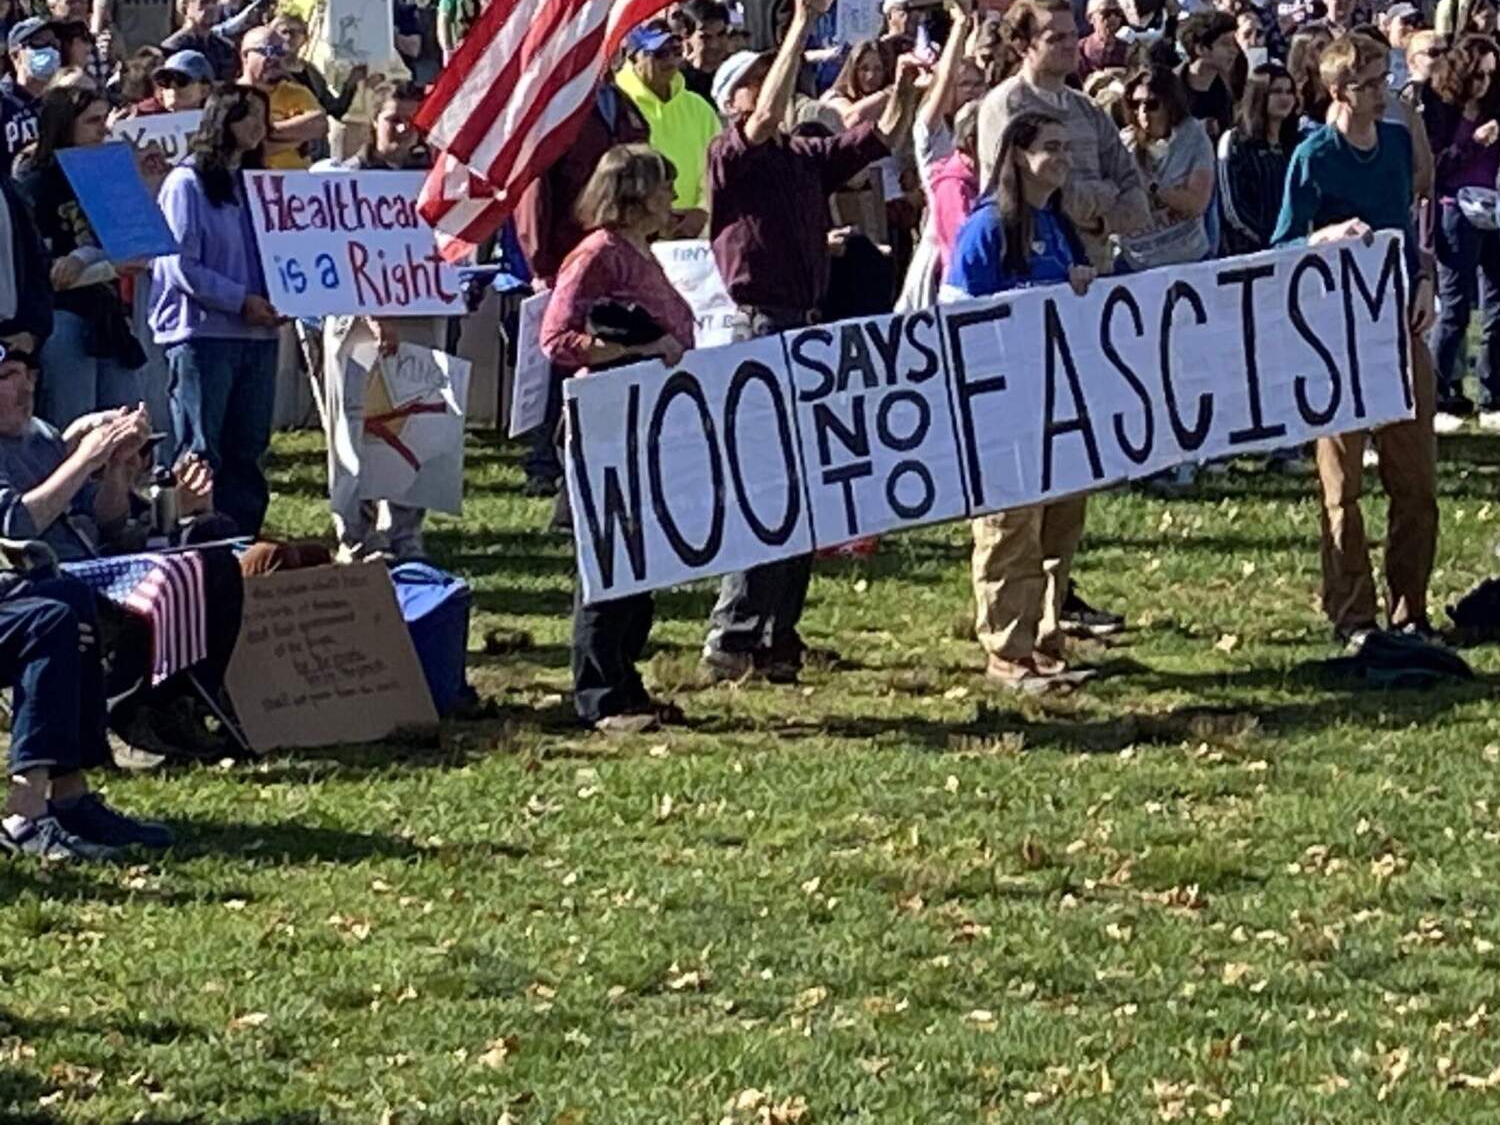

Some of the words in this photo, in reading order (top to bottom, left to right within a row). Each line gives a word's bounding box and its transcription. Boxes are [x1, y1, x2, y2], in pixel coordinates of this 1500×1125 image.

[252, 175, 419, 233] Healthcar
[273, 253, 308, 293] is
[314, 252, 341, 290] a
[347, 239, 459, 308] Right
[791, 307, 939, 403] SAYS
[945, 235, 1415, 507] FASCISM
[815, 389, 932, 467] NO
[566, 358, 800, 589] WOO
[820, 460, 936, 536] TO
